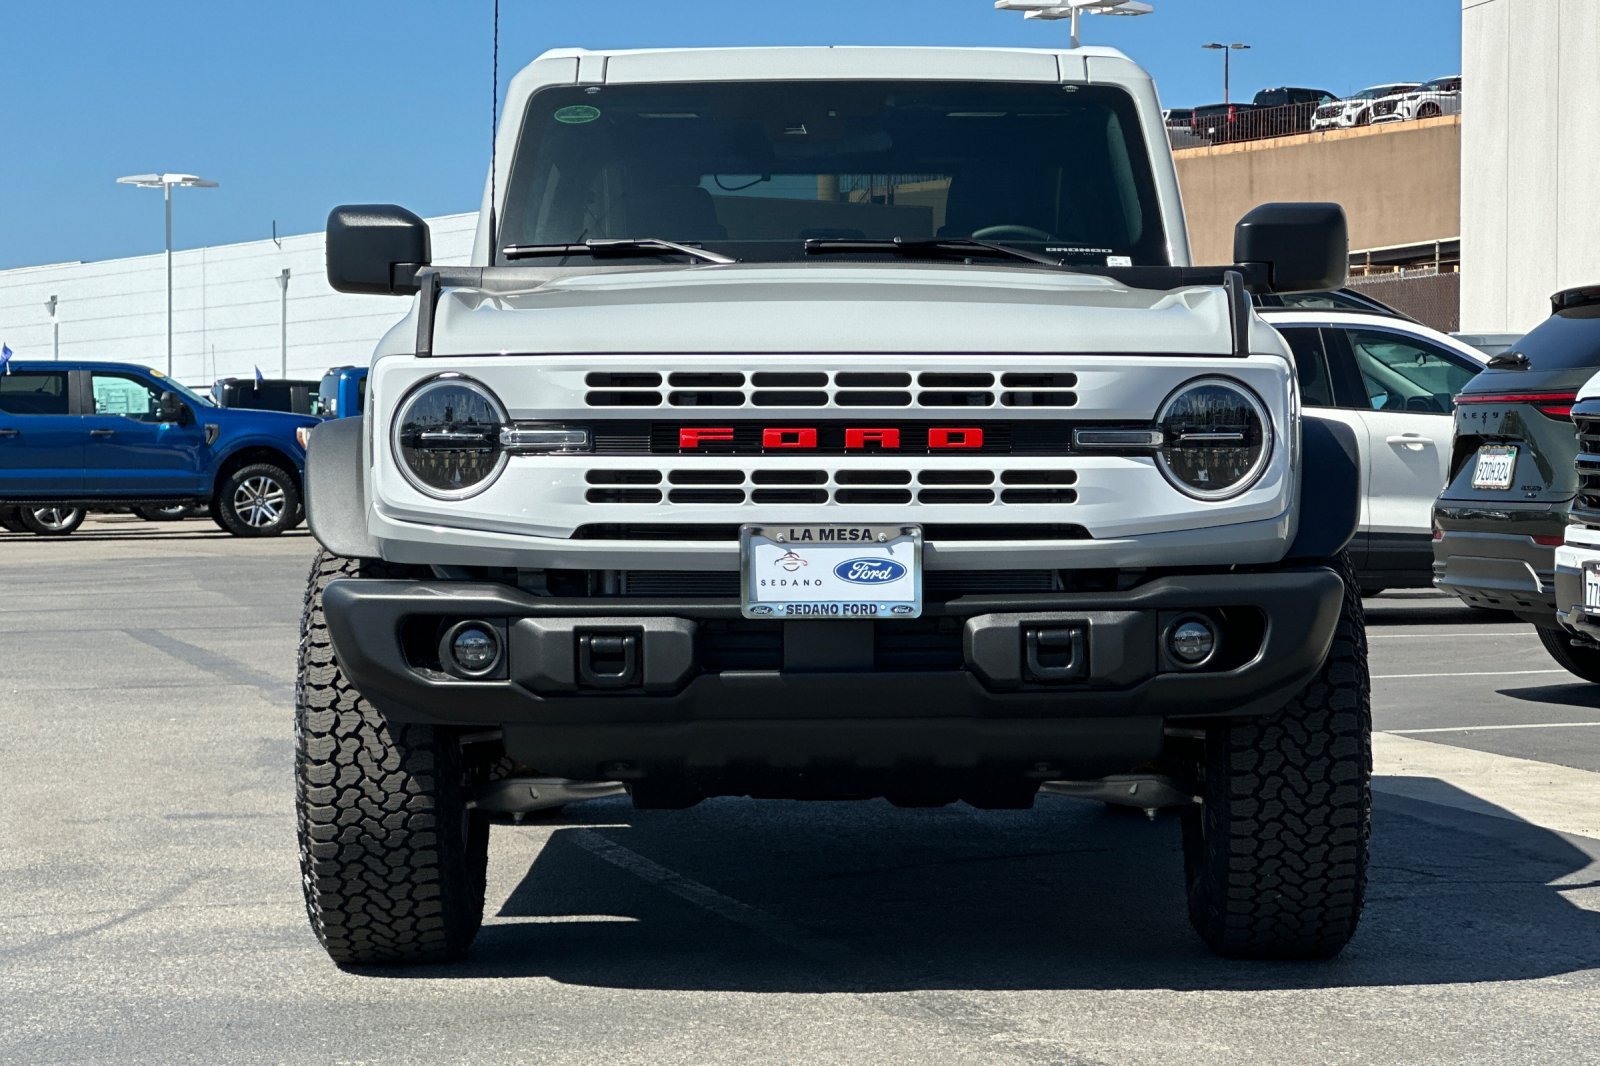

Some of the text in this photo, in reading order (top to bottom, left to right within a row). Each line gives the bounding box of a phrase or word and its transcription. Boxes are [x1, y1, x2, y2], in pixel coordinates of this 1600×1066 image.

[679, 427, 984, 448] FORD
[789, 528, 873, 541] LA MESA
[847, 561, 891, 580] Ford
[786, 604, 878, 615] SEDANO FORD
